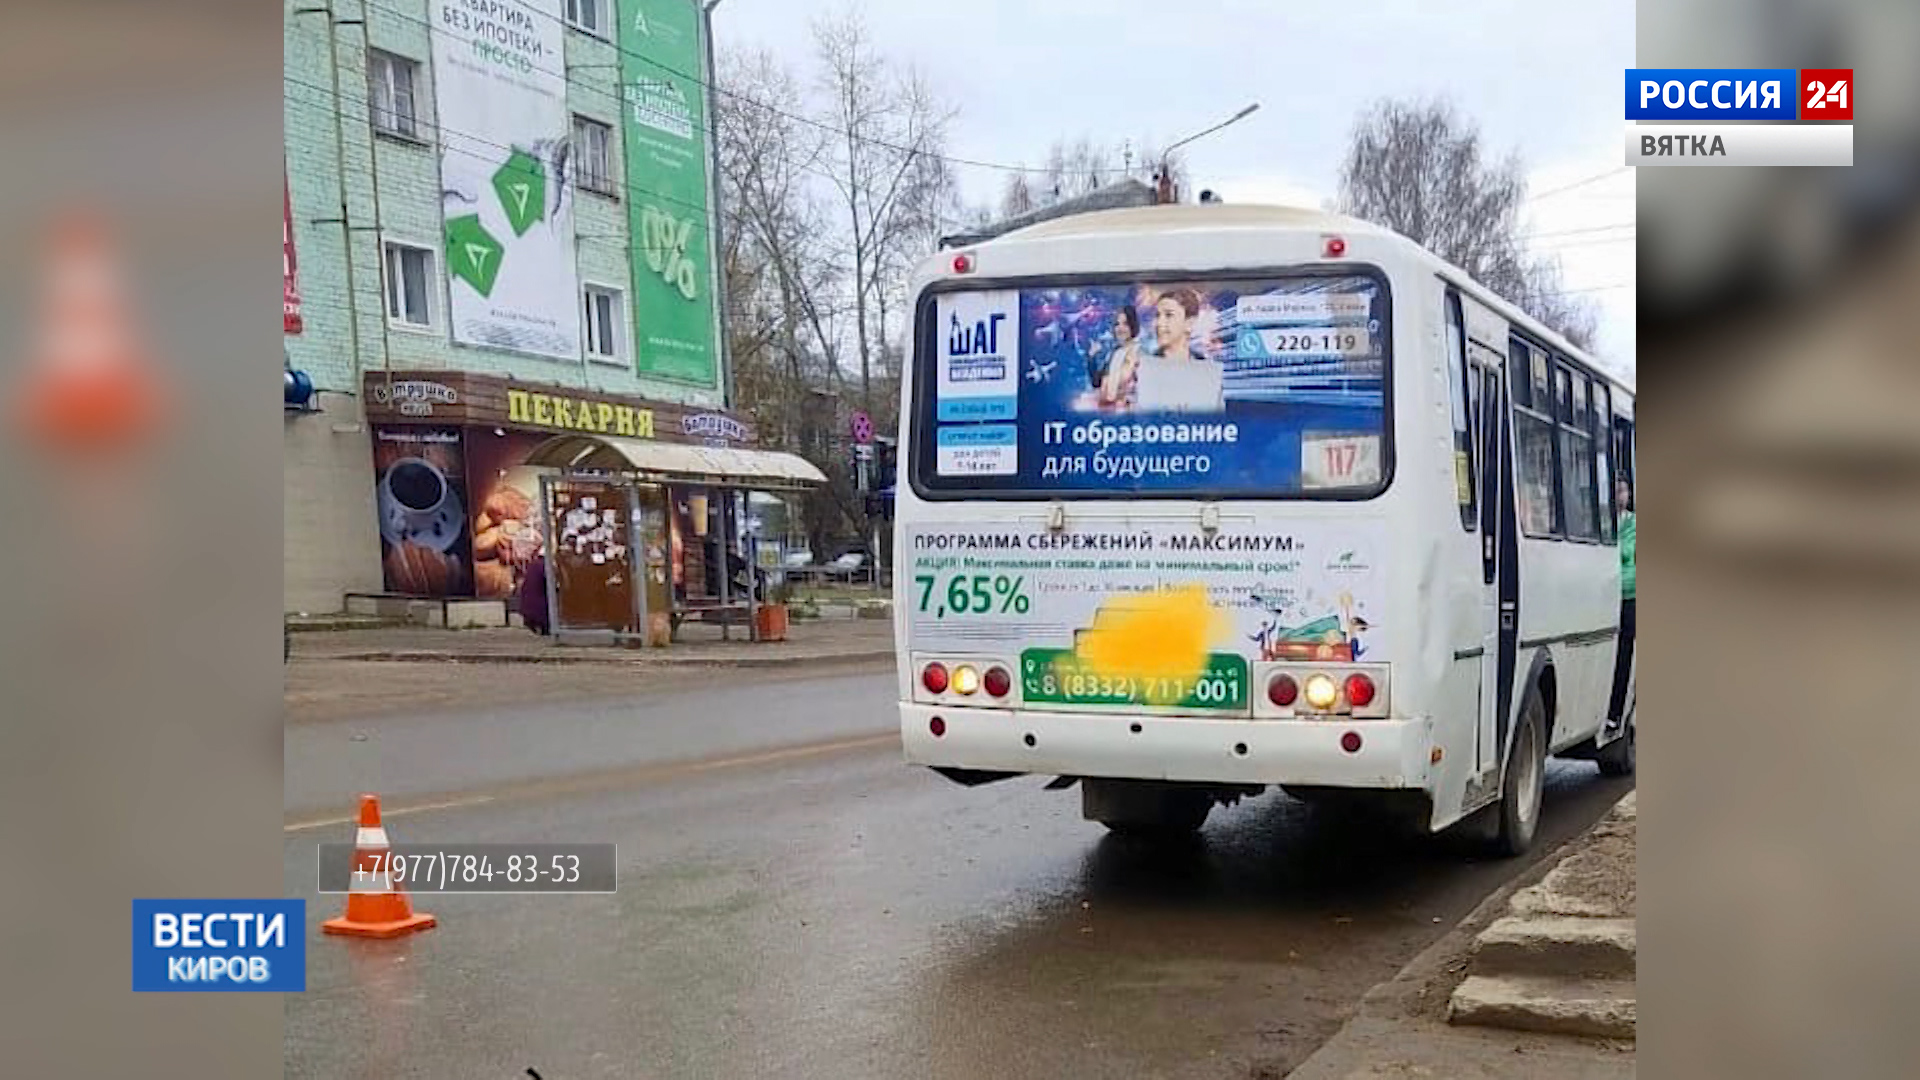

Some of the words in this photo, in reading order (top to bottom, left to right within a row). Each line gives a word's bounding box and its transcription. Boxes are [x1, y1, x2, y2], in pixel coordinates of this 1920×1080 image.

[443, 5, 470, 30] БЕЗ
[474, 16, 542, 57] ИПОТЕКИ
[471, 39, 532, 74] ПРОСТО
[950, 309, 1006, 356] ШАГ
[1276, 335, 1356, 351] 220-119
[508, 389, 655, 438] ПЕКАРНЯ
[1072, 419, 1239, 448] образование
[1042, 455, 1087, 478] для
[1092, 449, 1211, 478] будущего
[1325, 444, 1356, 477] 117
[915, 534, 1022, 550] ПРОГРАММА
[1027, 530, 1153, 550] СБЕРЕЖЕНИЙ
[1159, 534, 1305, 550] «МАКСИМУМ»
[963, 557, 1051, 569] Максимальная
[1055, 560, 1095, 569] ставка
[1098, 560, 1132, 570] даже
[1135, 560, 1151, 570] на
[1155, 558, 1254, 572] минимальный
[915, 575, 1029, 619] 7,65%
[1042, 675, 1056, 695] 8
[1063, 675, 1136, 700] (8332)
[1144, 677, 1239, 702] 711-001
